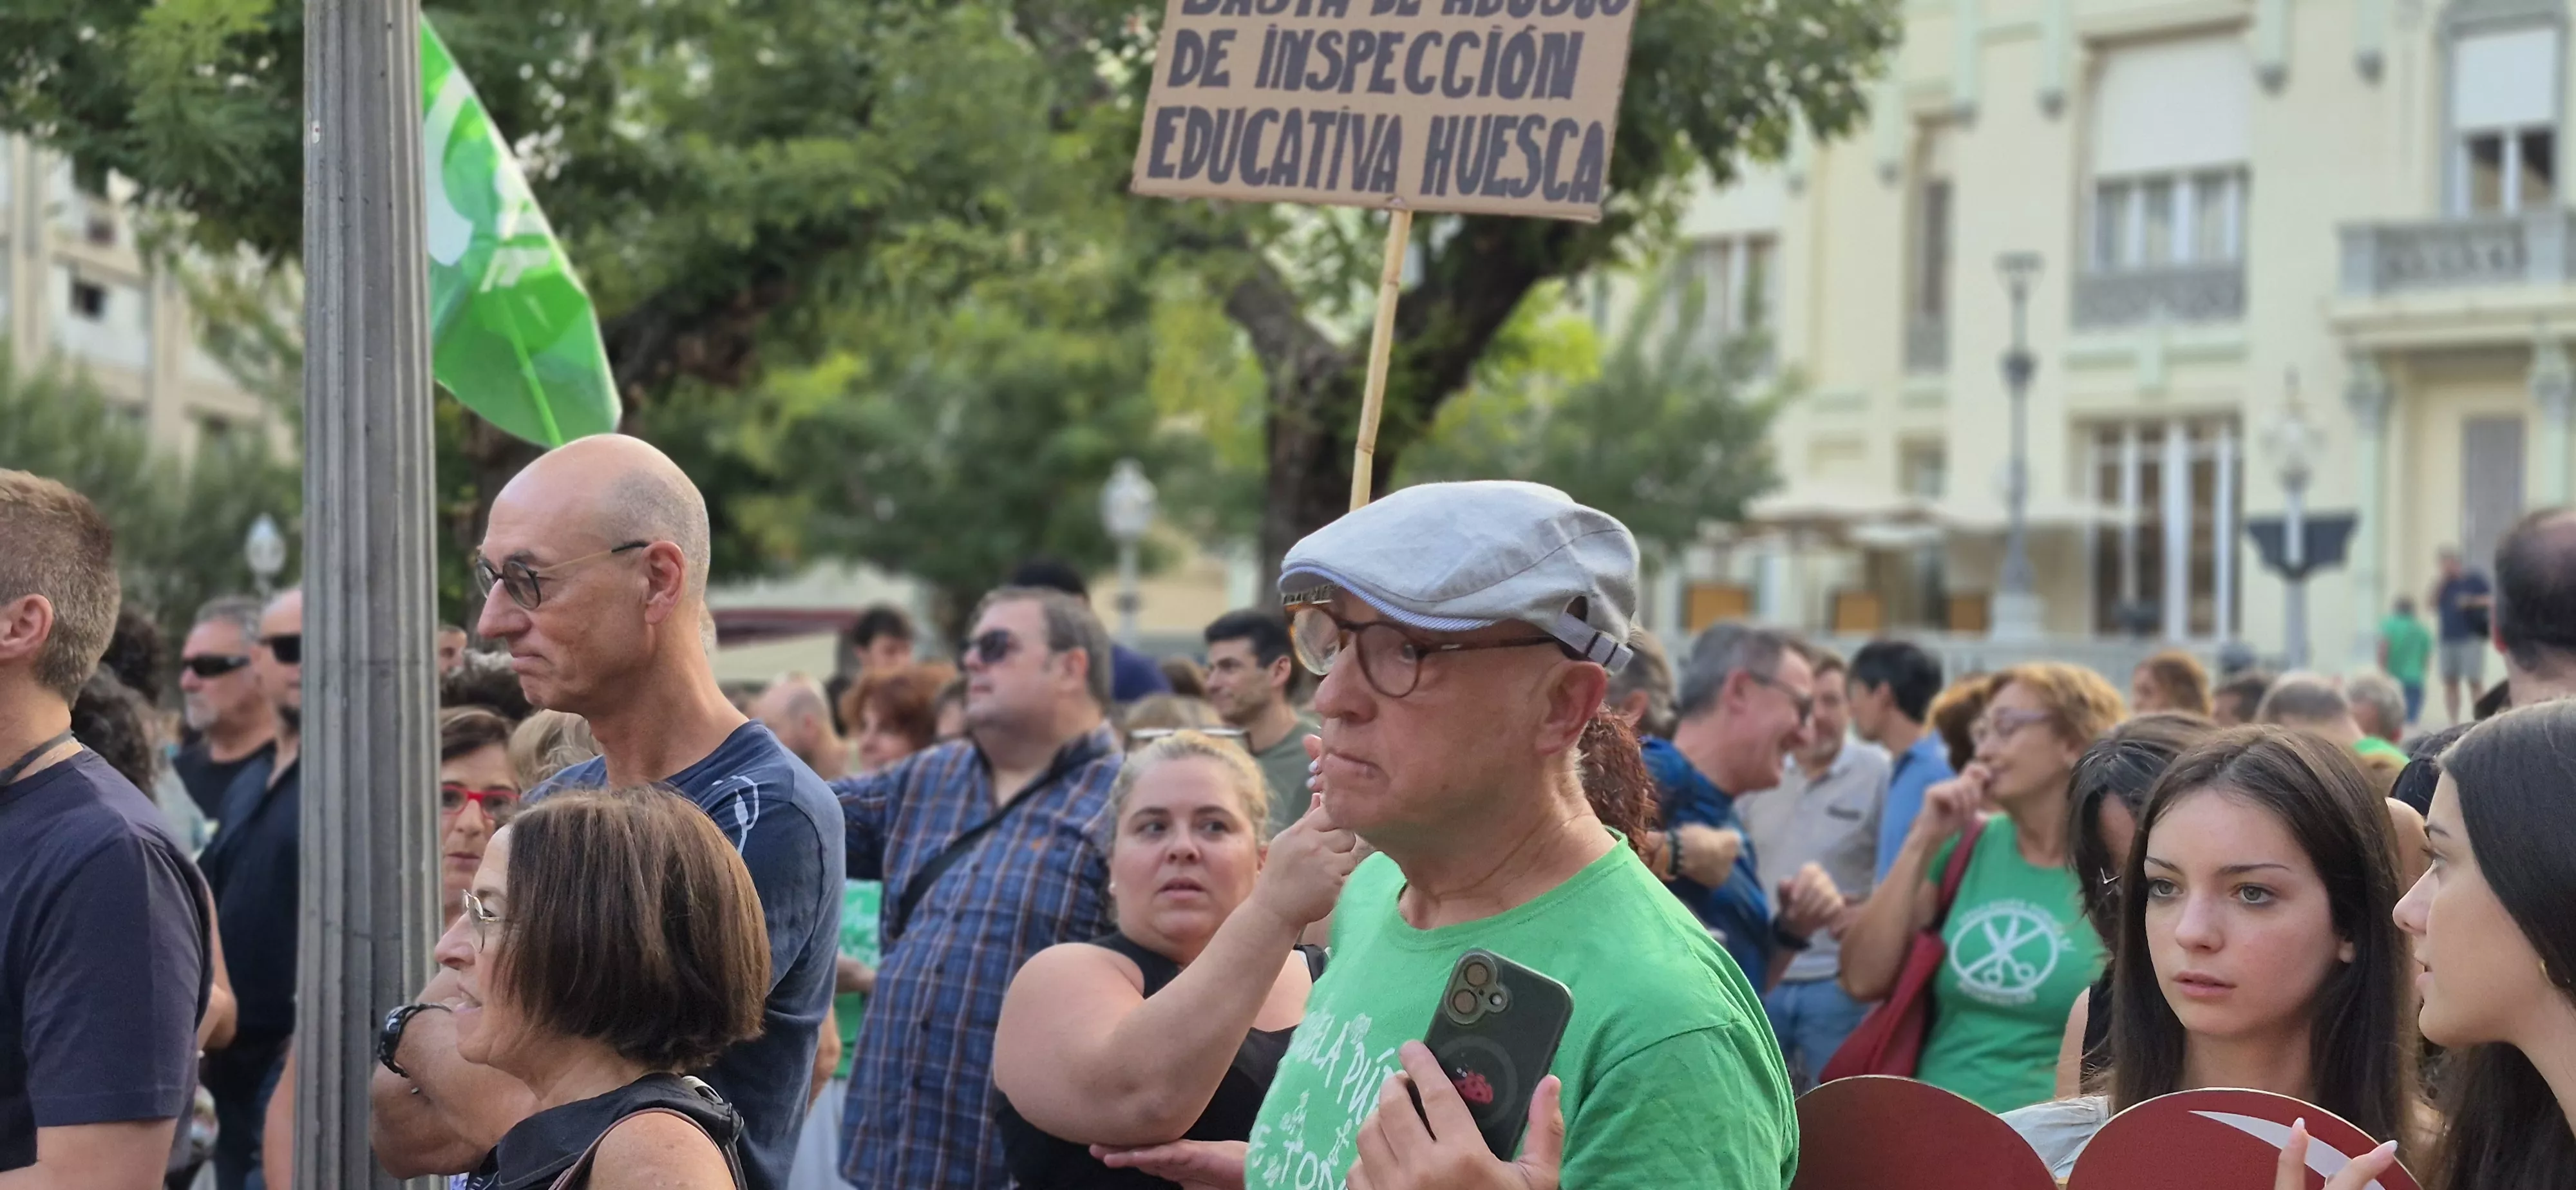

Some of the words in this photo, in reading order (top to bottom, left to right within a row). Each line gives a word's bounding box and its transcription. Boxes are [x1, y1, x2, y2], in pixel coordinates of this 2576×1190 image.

[1168, 30, 1236, 88] DE
[1255, 24, 1585, 99] INSPECCIÓN
[1146, 106, 1403, 194] EDUCATIVA
[1420, 113, 1604, 203] HUESCA
